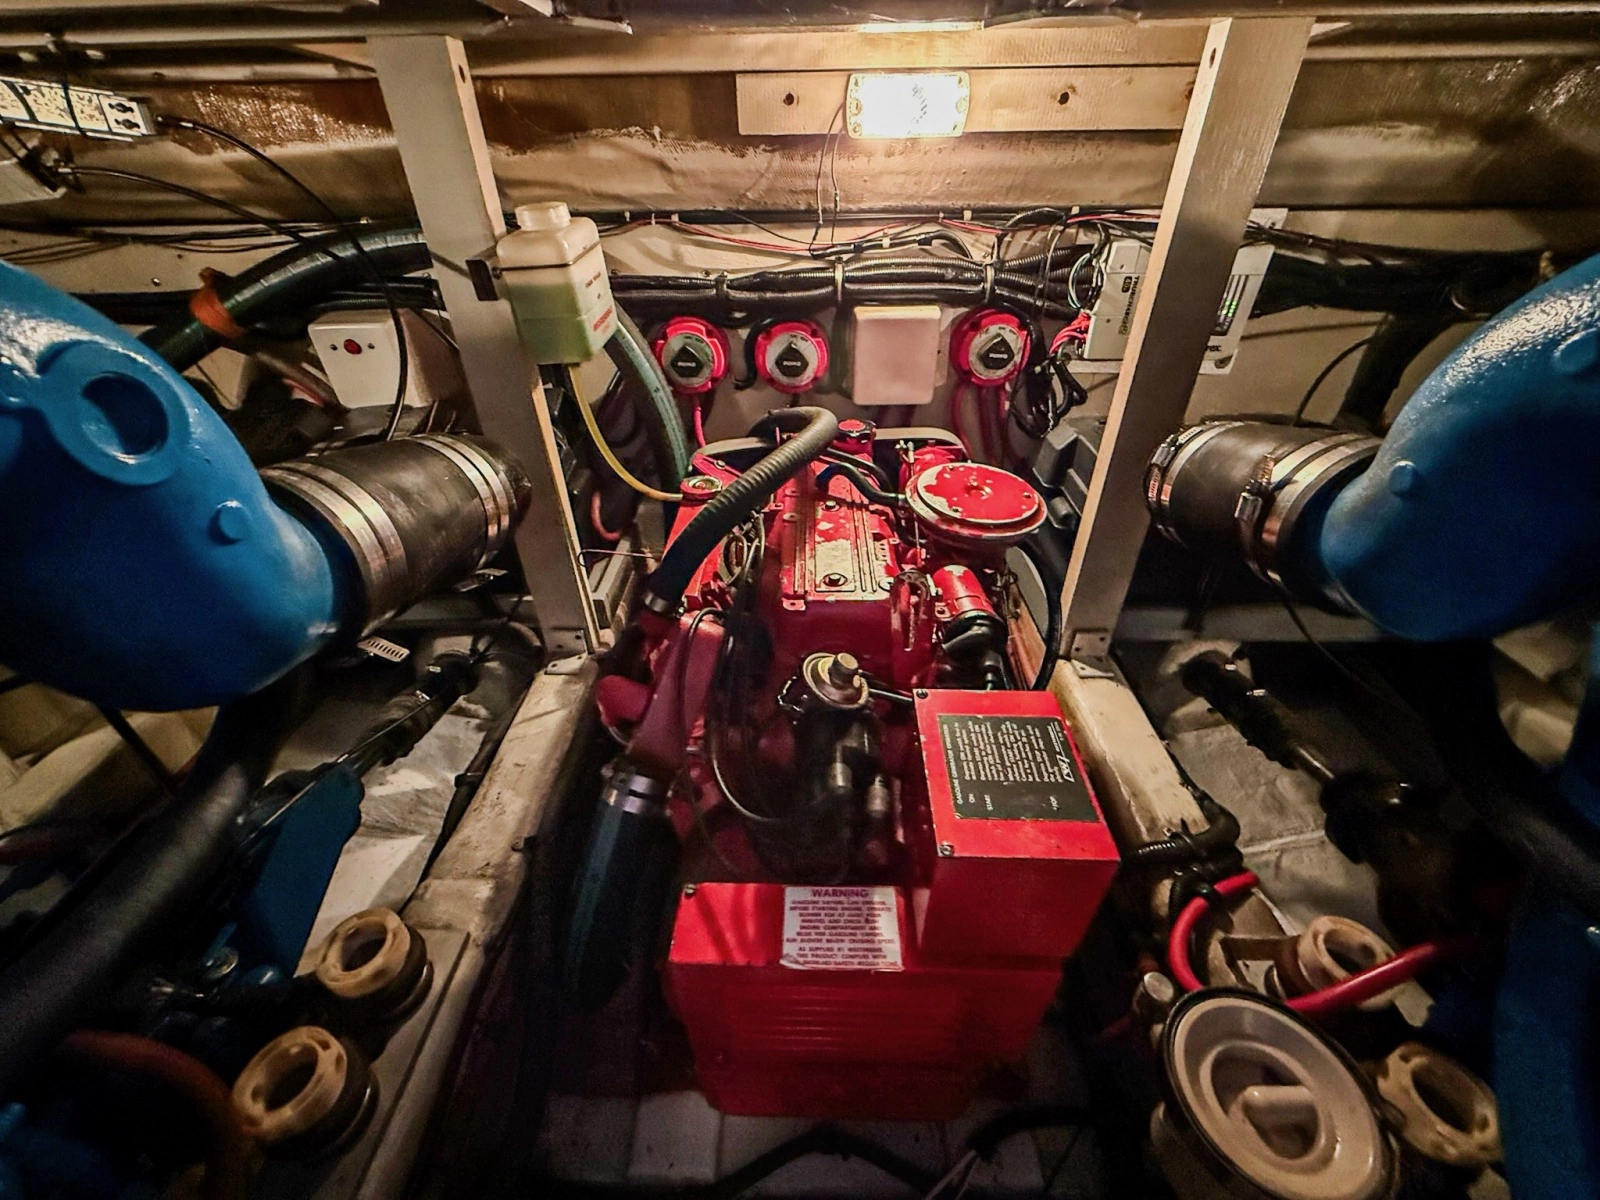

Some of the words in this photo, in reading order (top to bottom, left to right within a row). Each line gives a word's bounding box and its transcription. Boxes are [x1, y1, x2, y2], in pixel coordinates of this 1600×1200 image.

[942, 724, 952, 748] OPERATION
[947, 749, 957, 777] GENERATOR
[953, 779, 963, 804] GASOLINE
[968, 793, 975, 802] ON
[984, 794, 993, 810] START
[812, 889, 869, 898] WARNING
